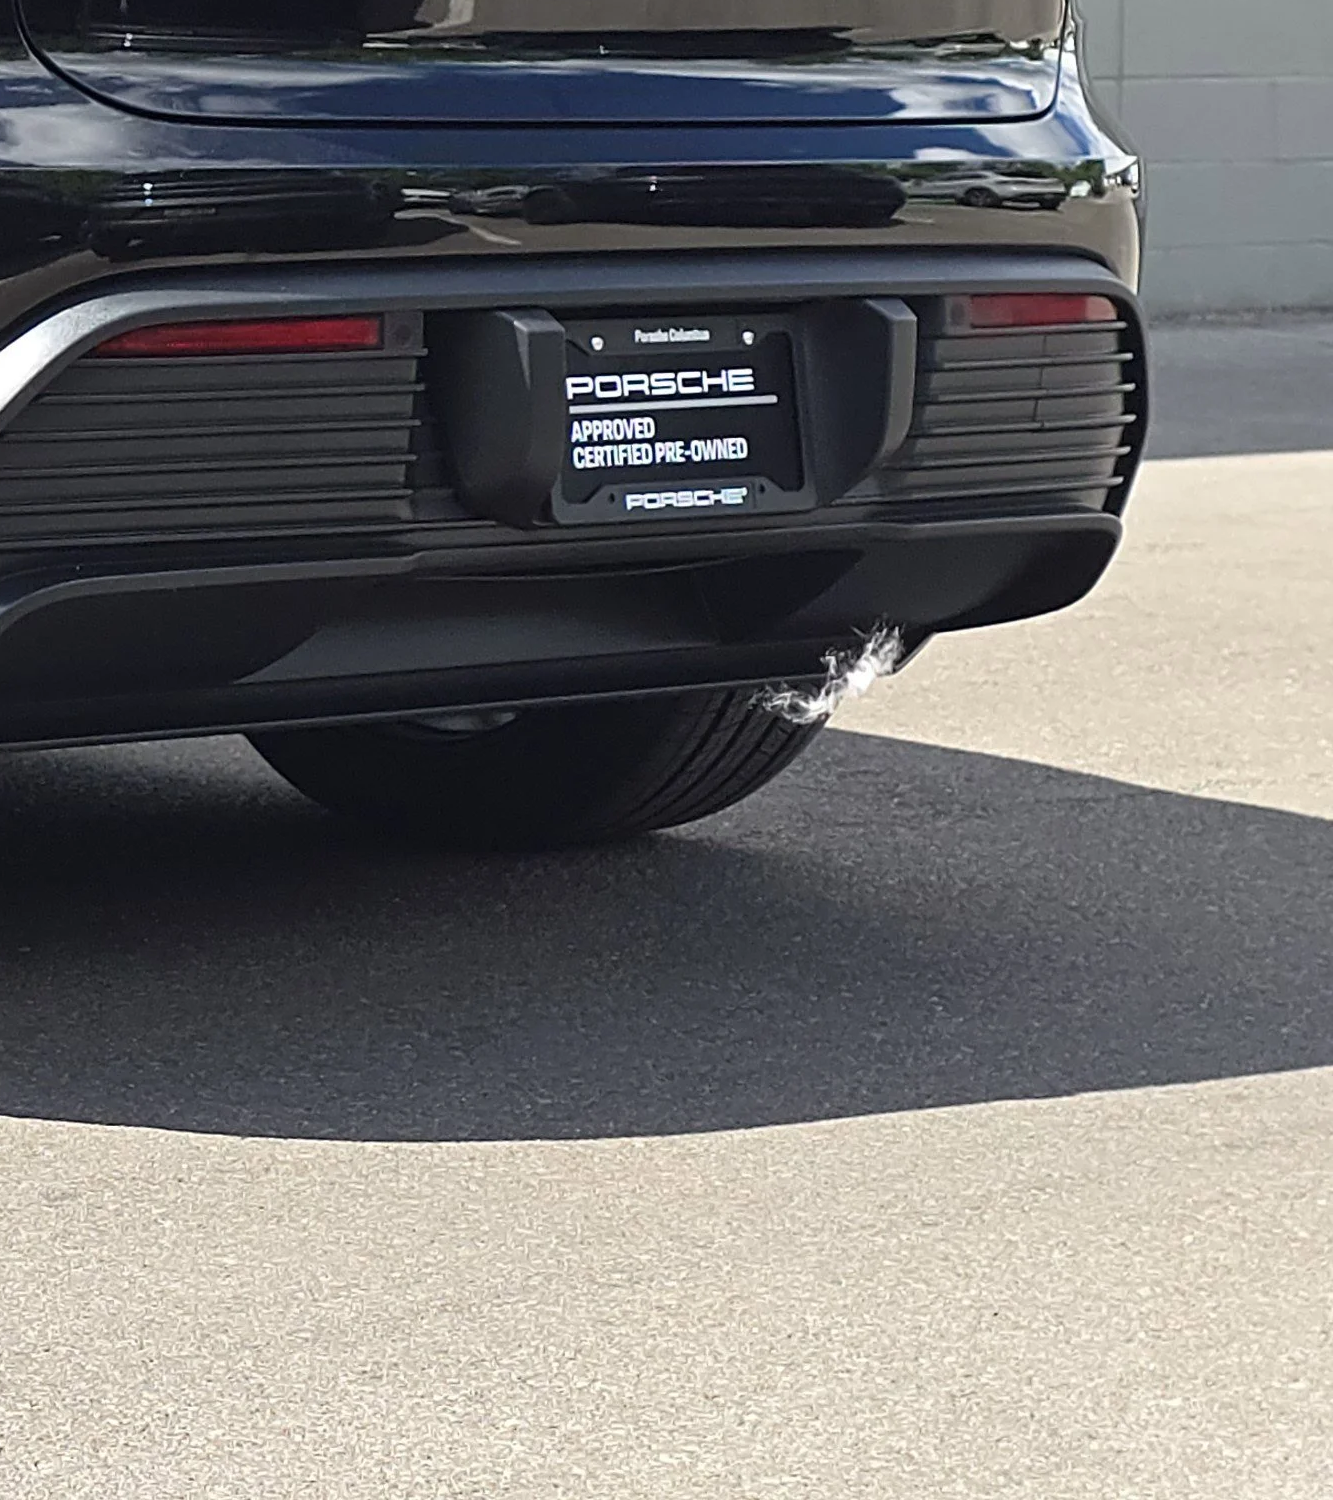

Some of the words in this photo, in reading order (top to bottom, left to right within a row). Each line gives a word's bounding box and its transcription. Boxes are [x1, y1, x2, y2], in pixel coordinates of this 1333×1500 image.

[565, 368, 755, 400] PORSCHE
[571, 417, 655, 443] APPROVED
[572, 443, 653, 470] CERTIFIED
[655, 437, 748, 464] PRE-OWNED
[625, 487, 746, 511] PORSCHE
